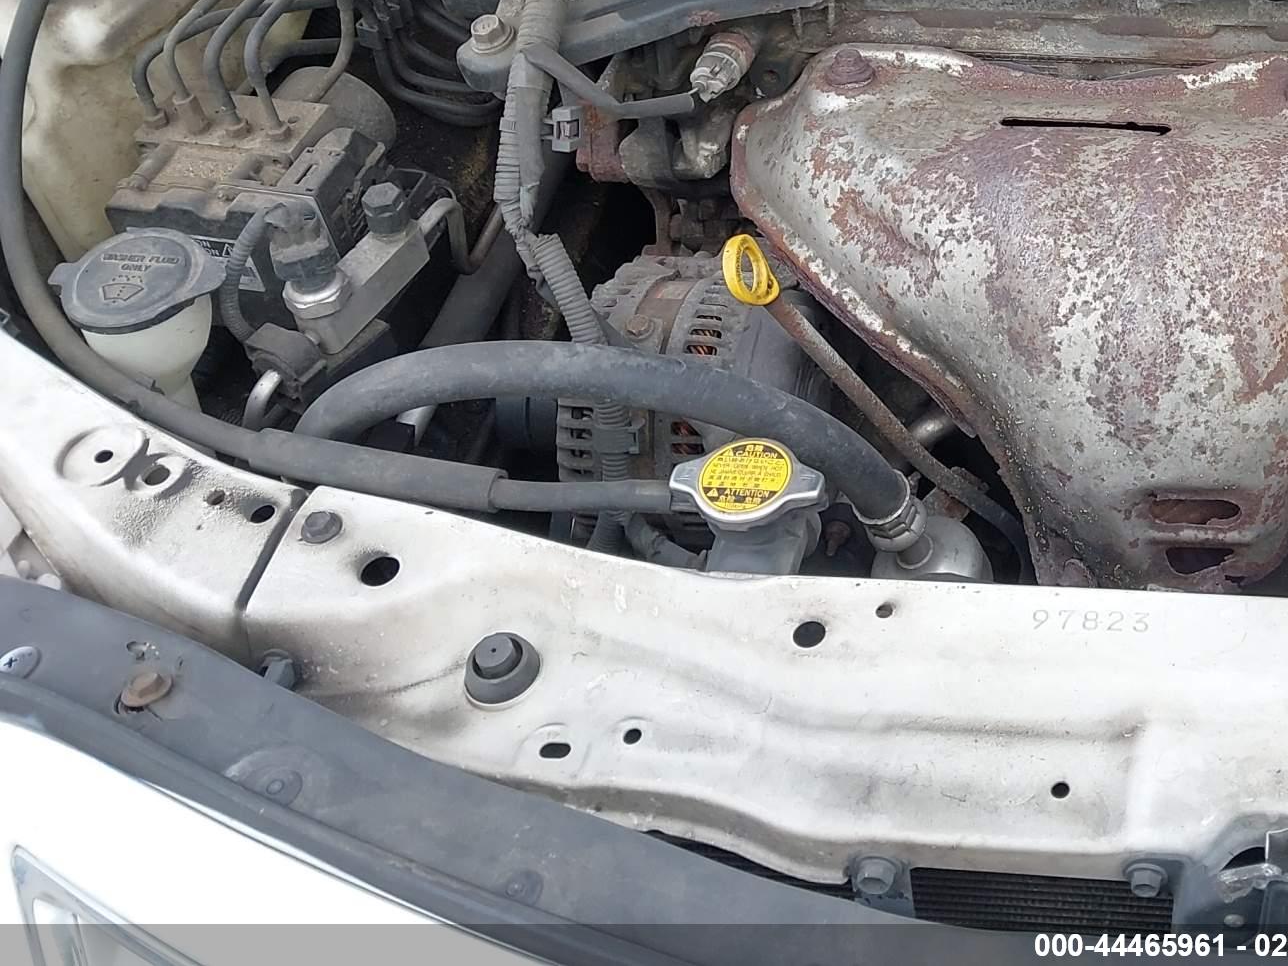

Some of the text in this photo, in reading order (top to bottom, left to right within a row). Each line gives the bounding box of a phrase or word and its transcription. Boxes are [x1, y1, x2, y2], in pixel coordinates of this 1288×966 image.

[121, 264, 152, 272] ONLY
[736, 450, 777, 458] CAUTION
[724, 488, 770, 497] ATTENTION
[1033, 609, 1149, 632] 97823
